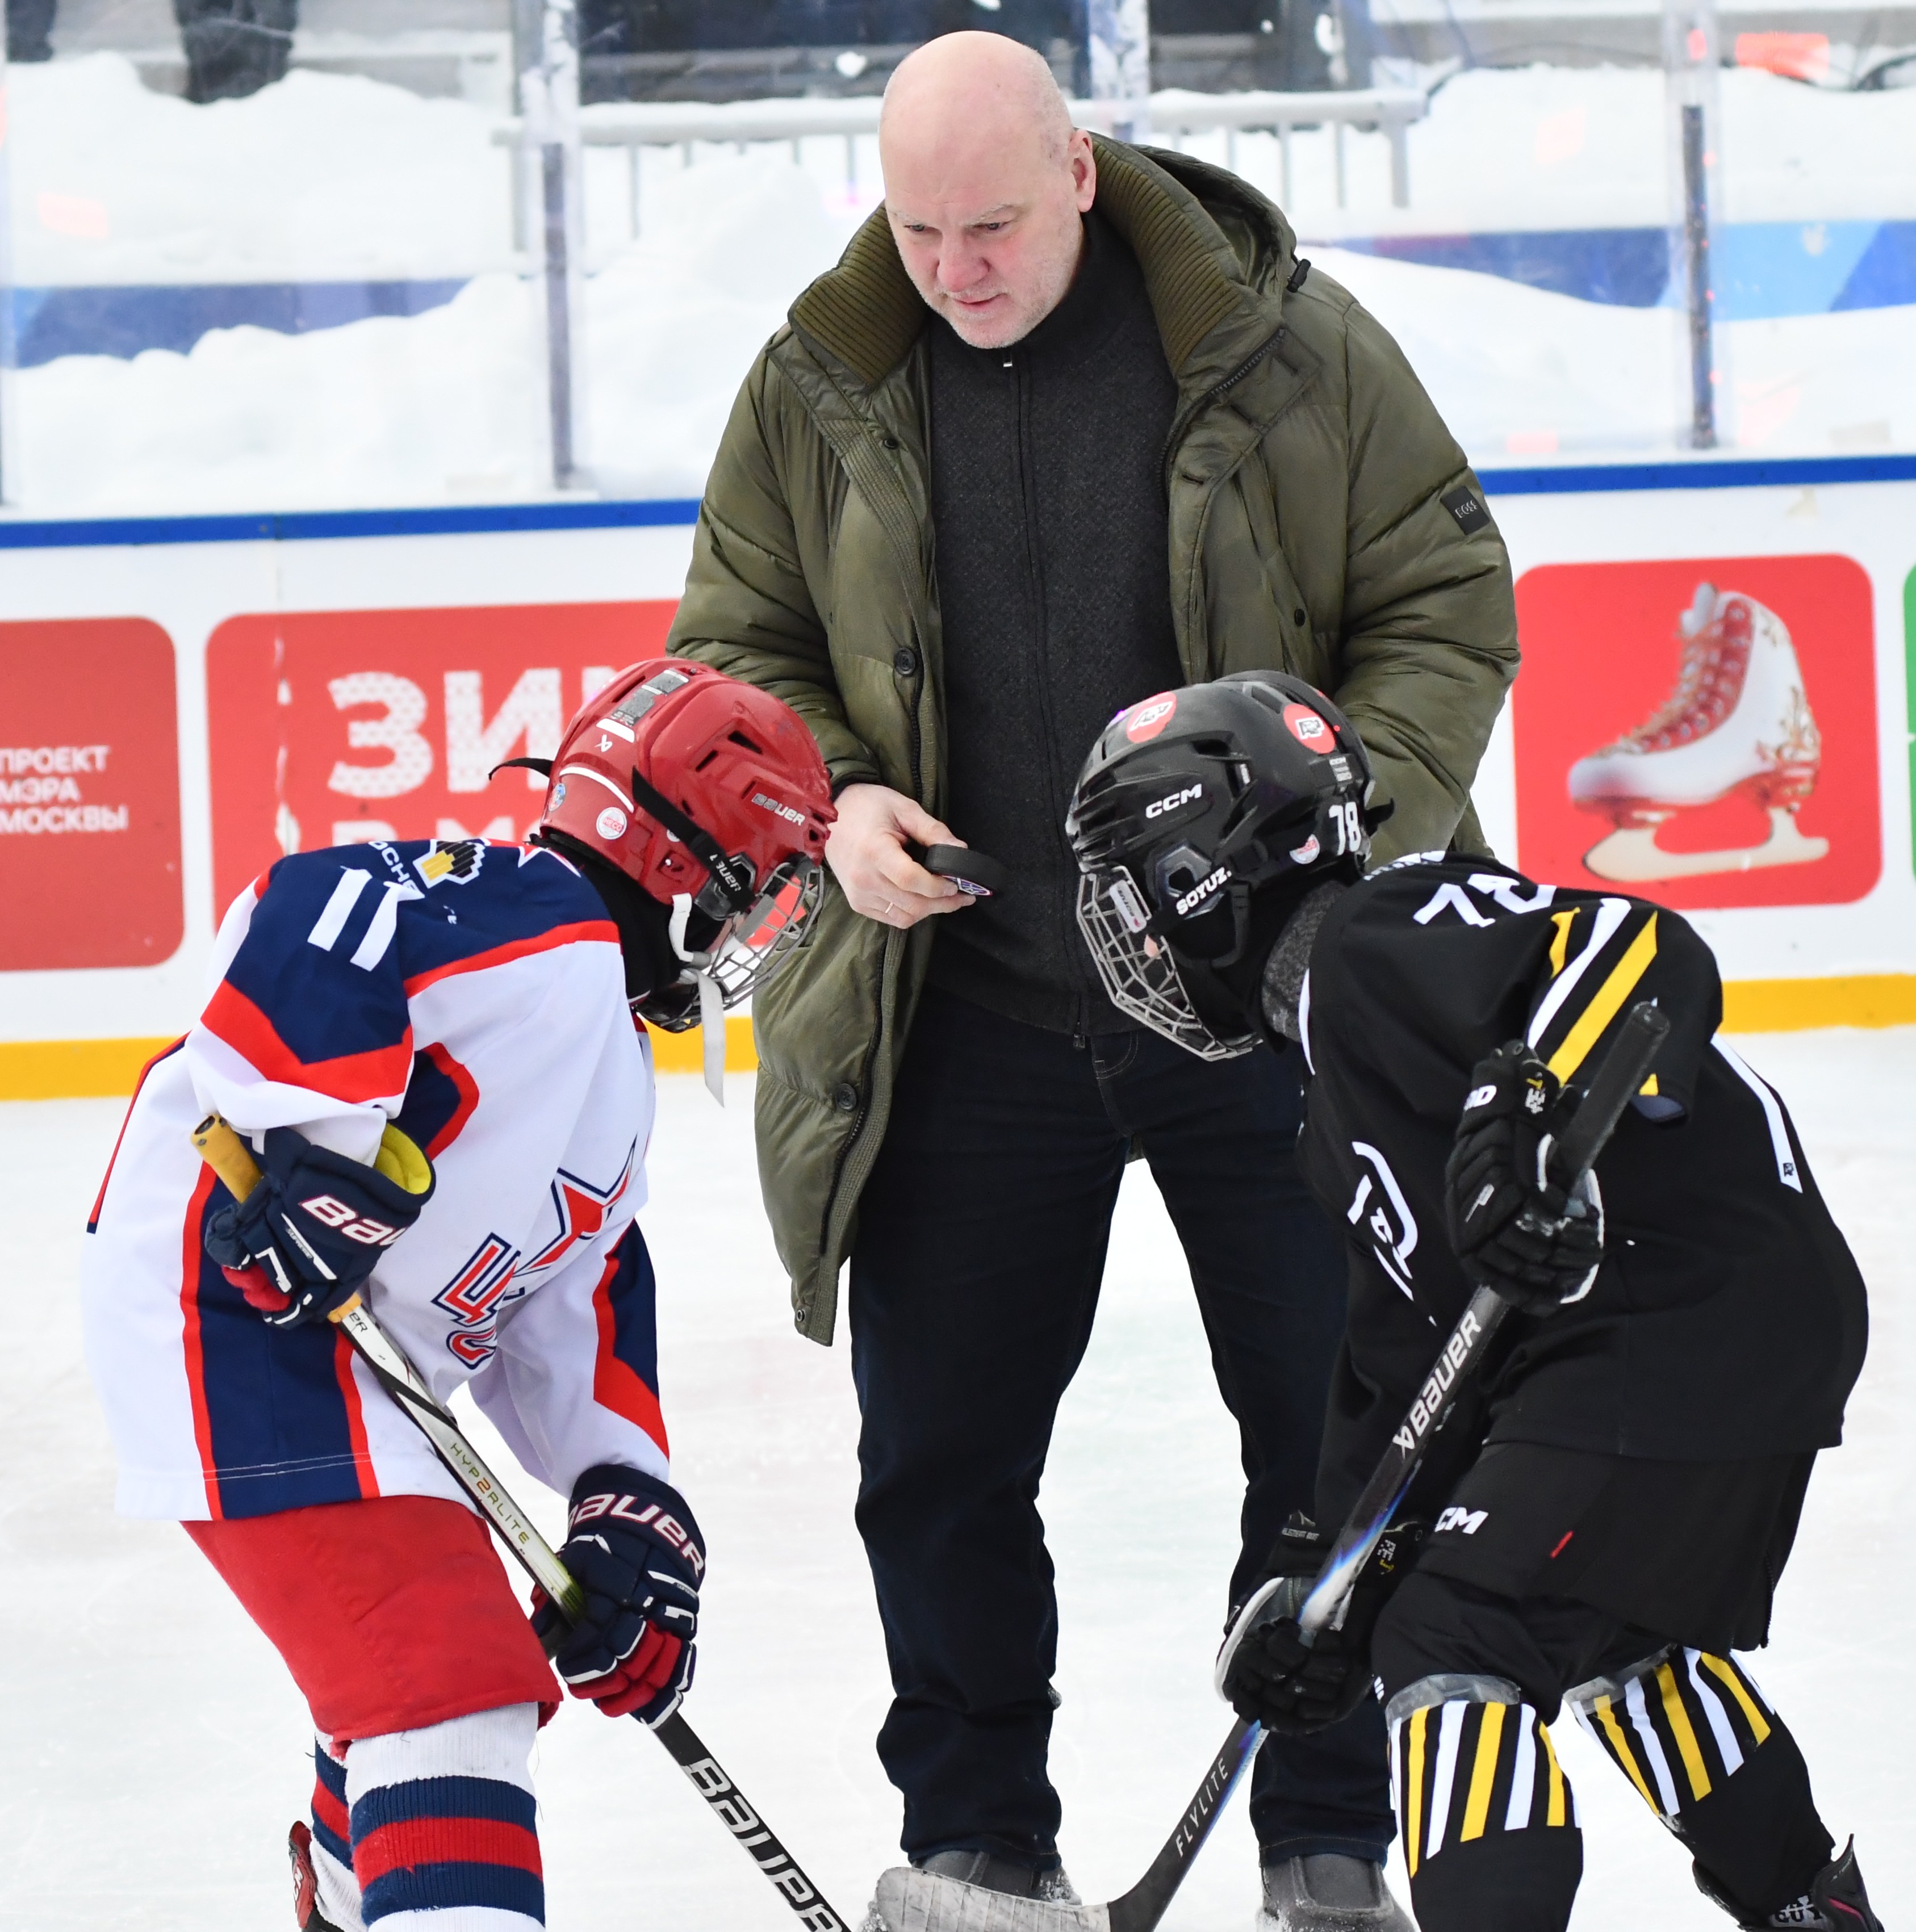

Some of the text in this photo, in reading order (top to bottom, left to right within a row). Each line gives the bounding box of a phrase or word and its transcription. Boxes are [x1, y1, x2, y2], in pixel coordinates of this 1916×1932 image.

[328, 665, 619, 798] ЗИ
[0, 745, 110, 774] ПРОЕКТ
[0, 777, 81, 804] МЭРА
[751, 793, 806, 826] BAUER
[1145, 783, 1202, 819] CCM
[0, 804, 129, 835] МОСКВЫ
[1329, 802, 1362, 856] 78
[1176, 866, 1232, 915] SOYUZ.
[1409, 1310, 1481, 1437] BAUER
[450, 1443, 530, 1544] HYP2RLITE
[1175, 1758, 1228, 1858] FLYLITE
